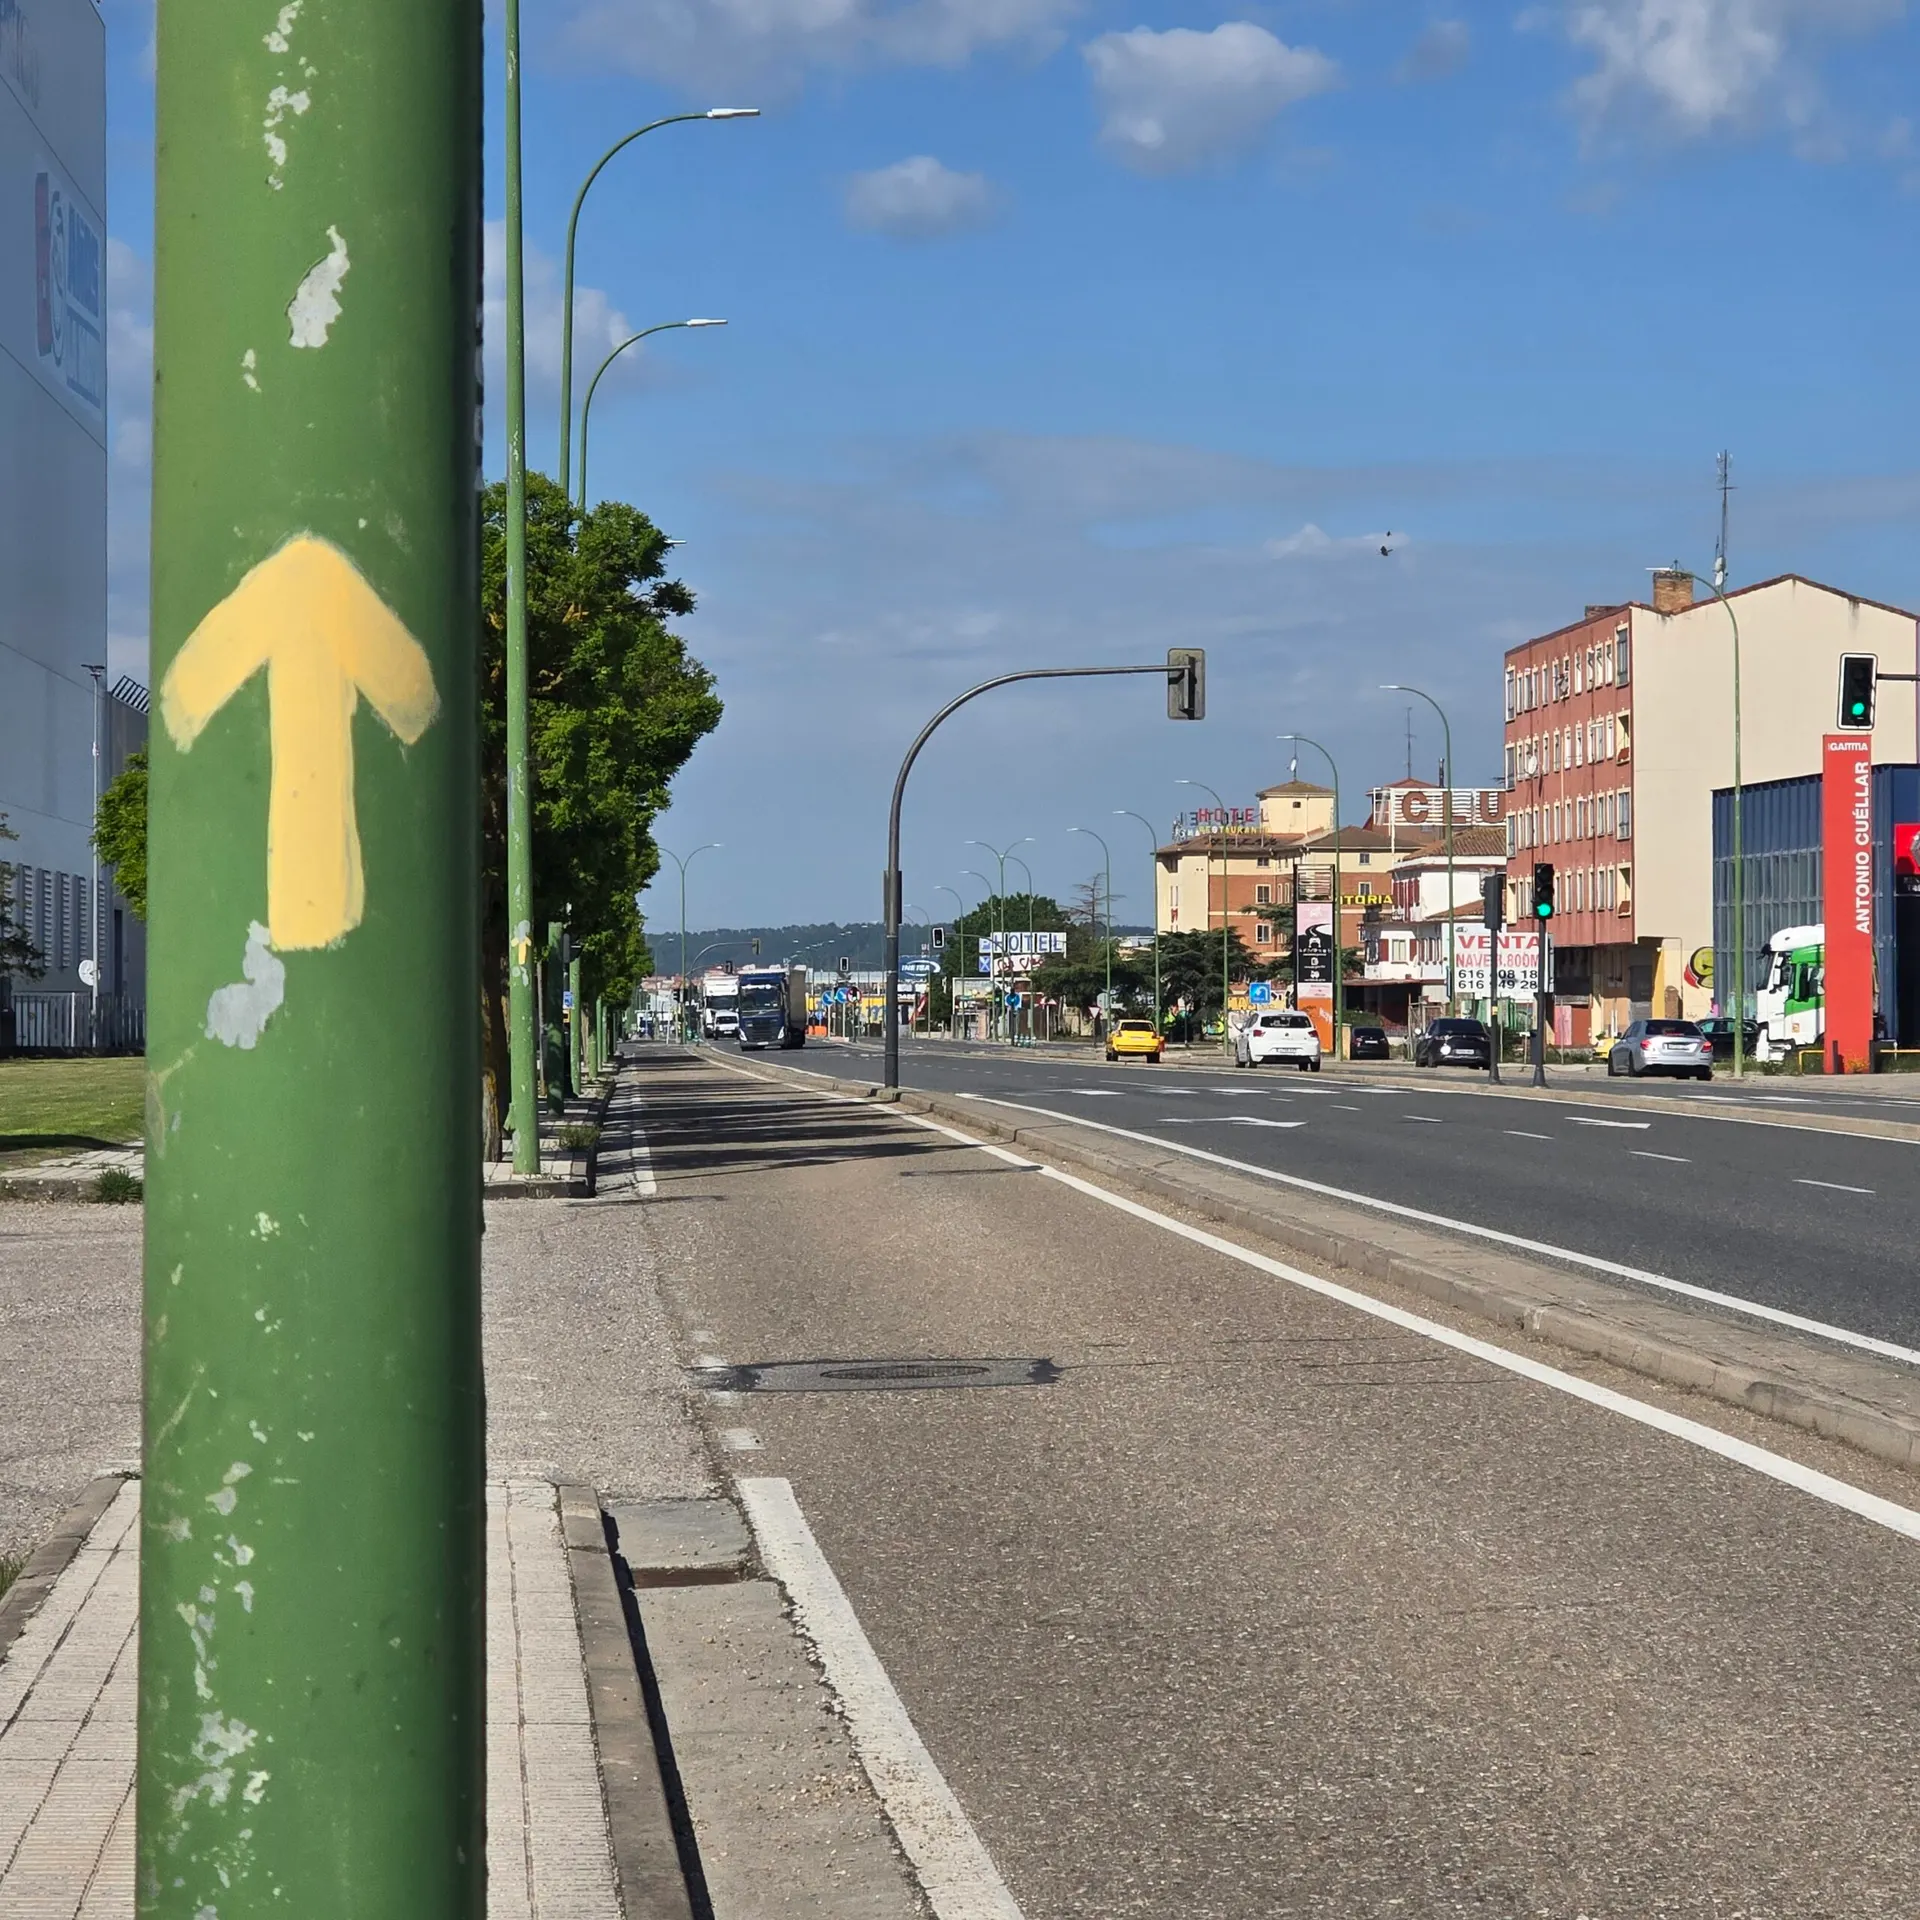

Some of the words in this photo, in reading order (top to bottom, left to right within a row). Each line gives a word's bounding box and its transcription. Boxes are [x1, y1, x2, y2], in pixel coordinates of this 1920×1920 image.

[1852, 762, 1870, 846] CUÉLLAR
[1197, 808, 1269, 822] HOTEL
[1855, 852, 1870, 934] ANTONIO
[994, 934, 1062, 952] HOTEL
[1458, 935, 1540, 949] VENTA
[1456, 953, 1491, 967] NAVE
[1458, 969, 1485, 979] 616
[1490, 969, 1515, 979] 08
[1520, 969, 1538, 979] 18
[1458, 980, 1485, 990] 616
[1490, 980, 1515, 989] 49
[1520, 980, 1538, 990] 28
